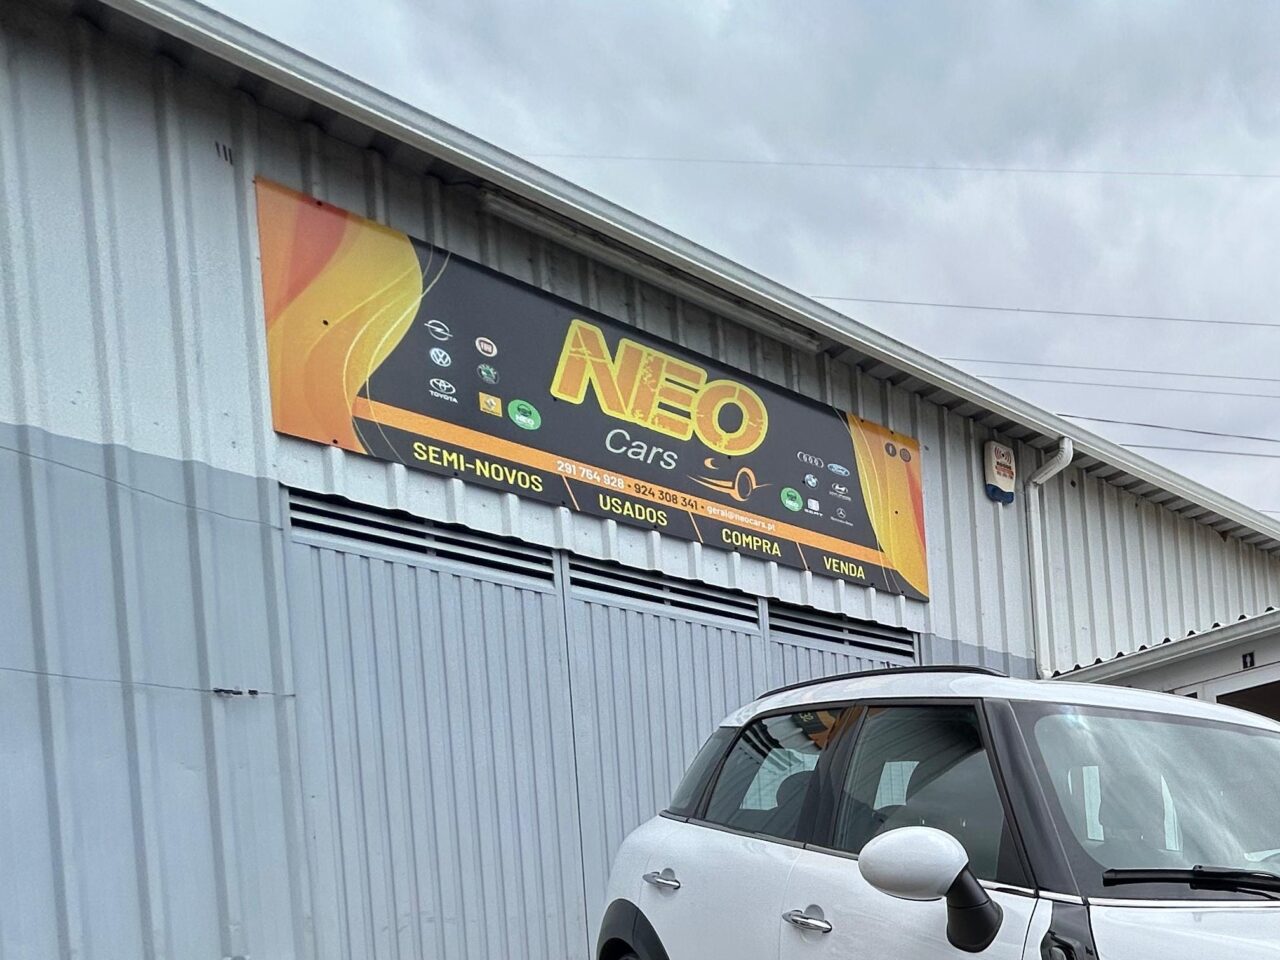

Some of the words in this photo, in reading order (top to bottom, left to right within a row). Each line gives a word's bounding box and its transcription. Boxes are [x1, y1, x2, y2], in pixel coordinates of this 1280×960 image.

[429, 390, 458, 403] TOYOTA
[550, 318, 768, 456] NEO
[413, 442, 543, 492] SEMI-NOVOS
[605, 429, 679, 470] Cars
[557, 460, 577, 475] 291
[579, 466, 601, 483] 764
[603, 475, 625, 490] 928
[634, 482, 656, 498] 924
[658, 490, 679, 505] 308
[681, 497, 698, 510] 341
[599, 493, 668, 526] USADOS
[722, 528, 782, 557] COMPRA
[823, 556, 866, 580] VENDA
